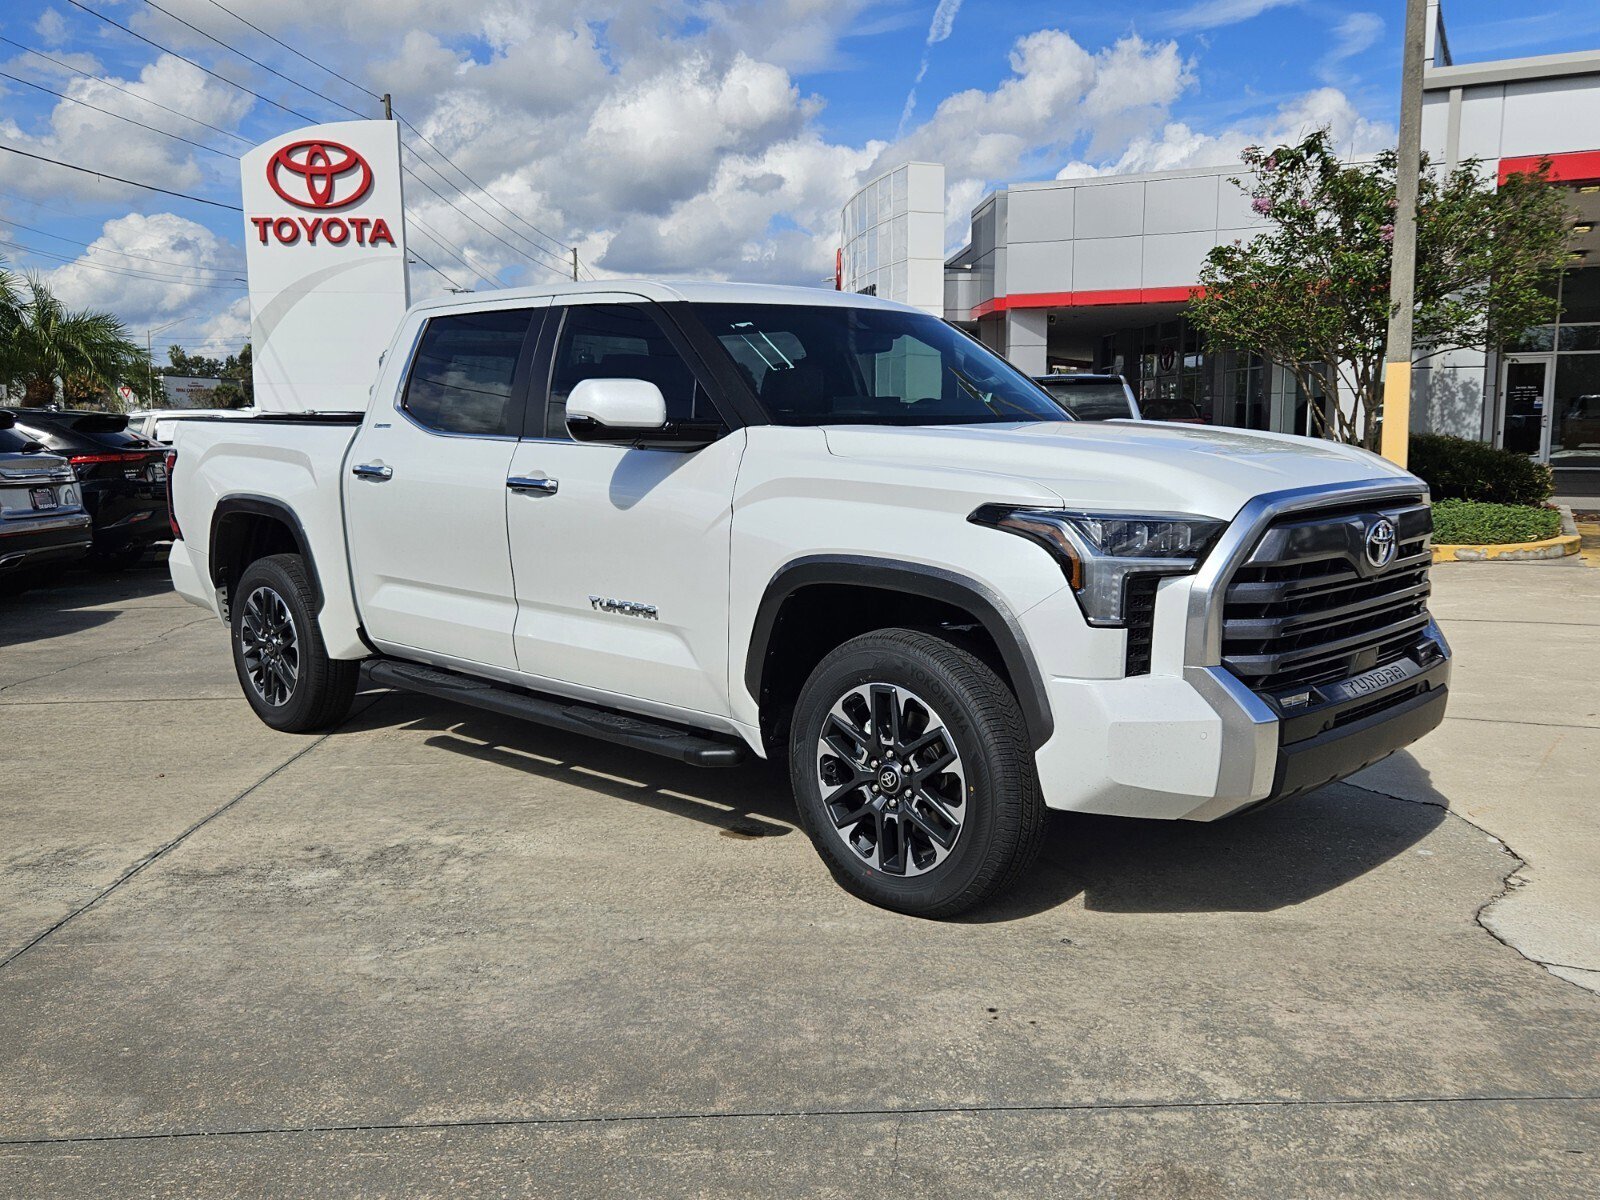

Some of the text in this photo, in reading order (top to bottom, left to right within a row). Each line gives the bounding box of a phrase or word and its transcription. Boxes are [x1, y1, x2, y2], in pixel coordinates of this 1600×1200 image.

[251, 217, 395, 245] TOYOTA
[588, 595, 659, 620] TUNDRA
[1342, 665, 1407, 695] TUNDRA
[909, 663, 970, 736] YOKOHAMA
